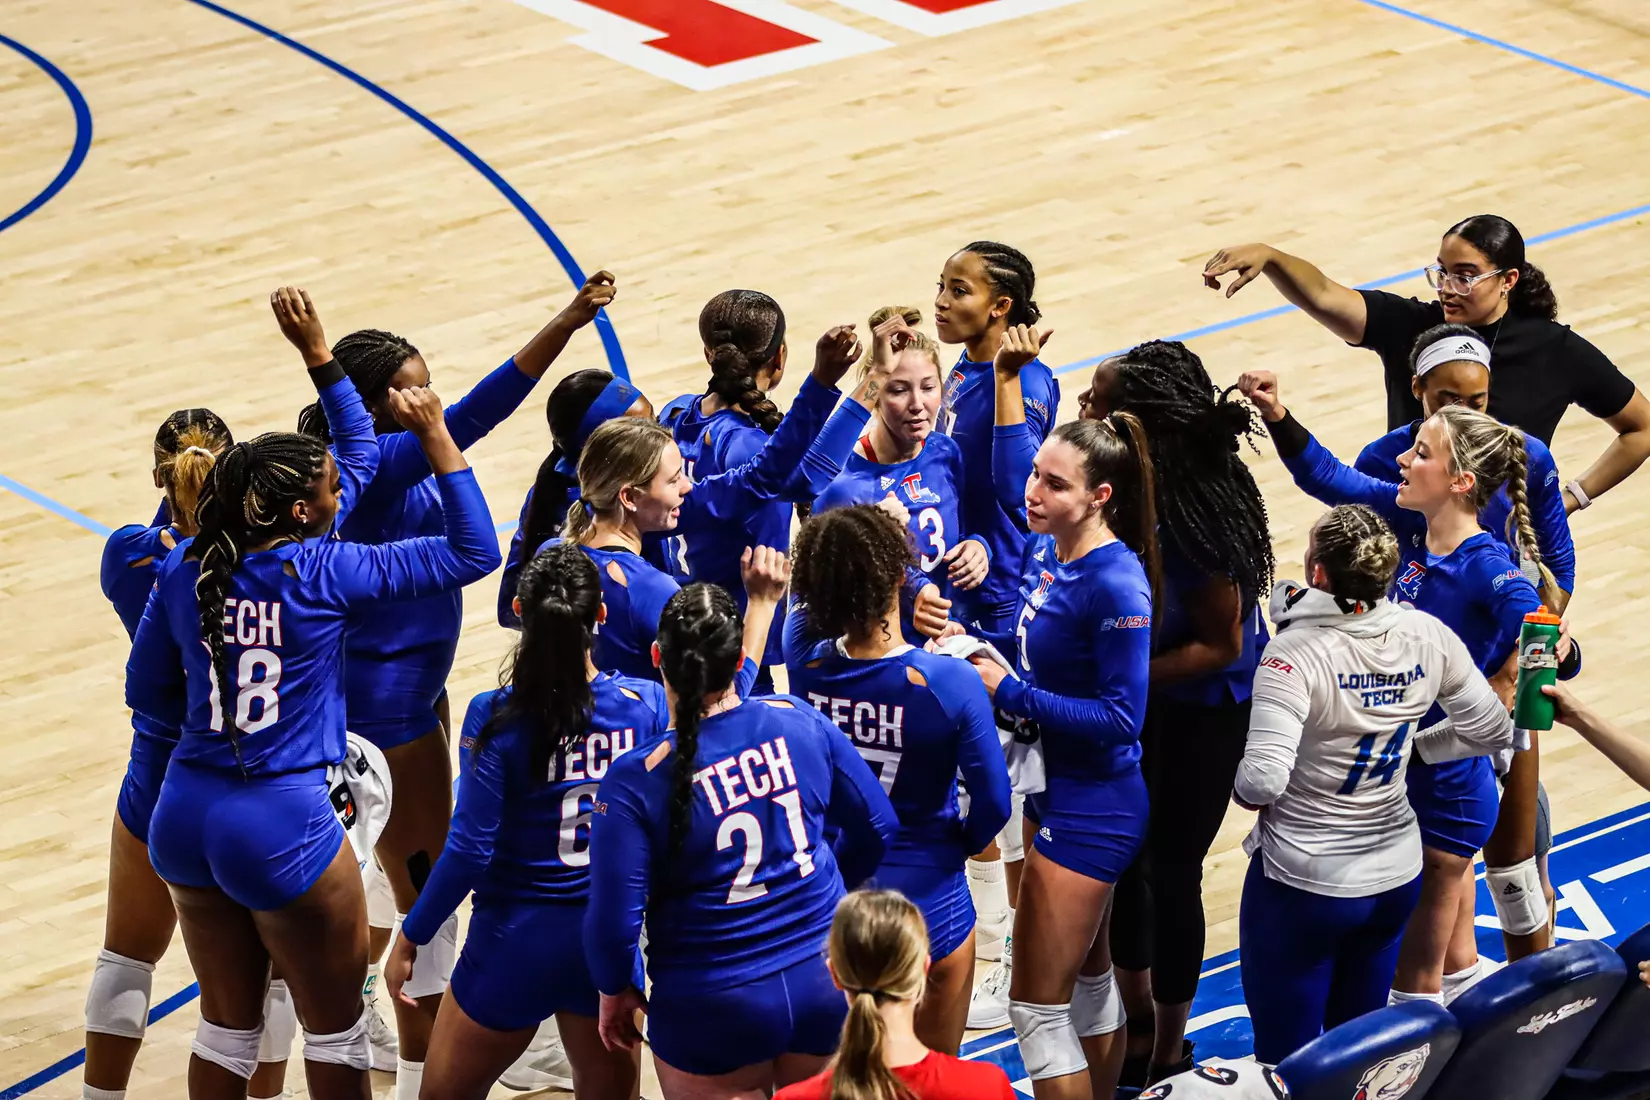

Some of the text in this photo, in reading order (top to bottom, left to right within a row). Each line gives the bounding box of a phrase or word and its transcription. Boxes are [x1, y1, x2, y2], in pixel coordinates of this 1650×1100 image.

[918, 507, 946, 573] 3
[223, 598, 282, 647] ECH
[1016, 602, 1036, 672] 5
[200, 640, 282, 735] 18
[1260, 656, 1293, 674] USA
[1361, 689, 1406, 708] TECH
[691, 736, 798, 816] TECH
[854, 747, 903, 797] 7
[1335, 721, 1411, 795] 14
[557, 783, 600, 867] 6
[716, 789, 816, 904] 21
